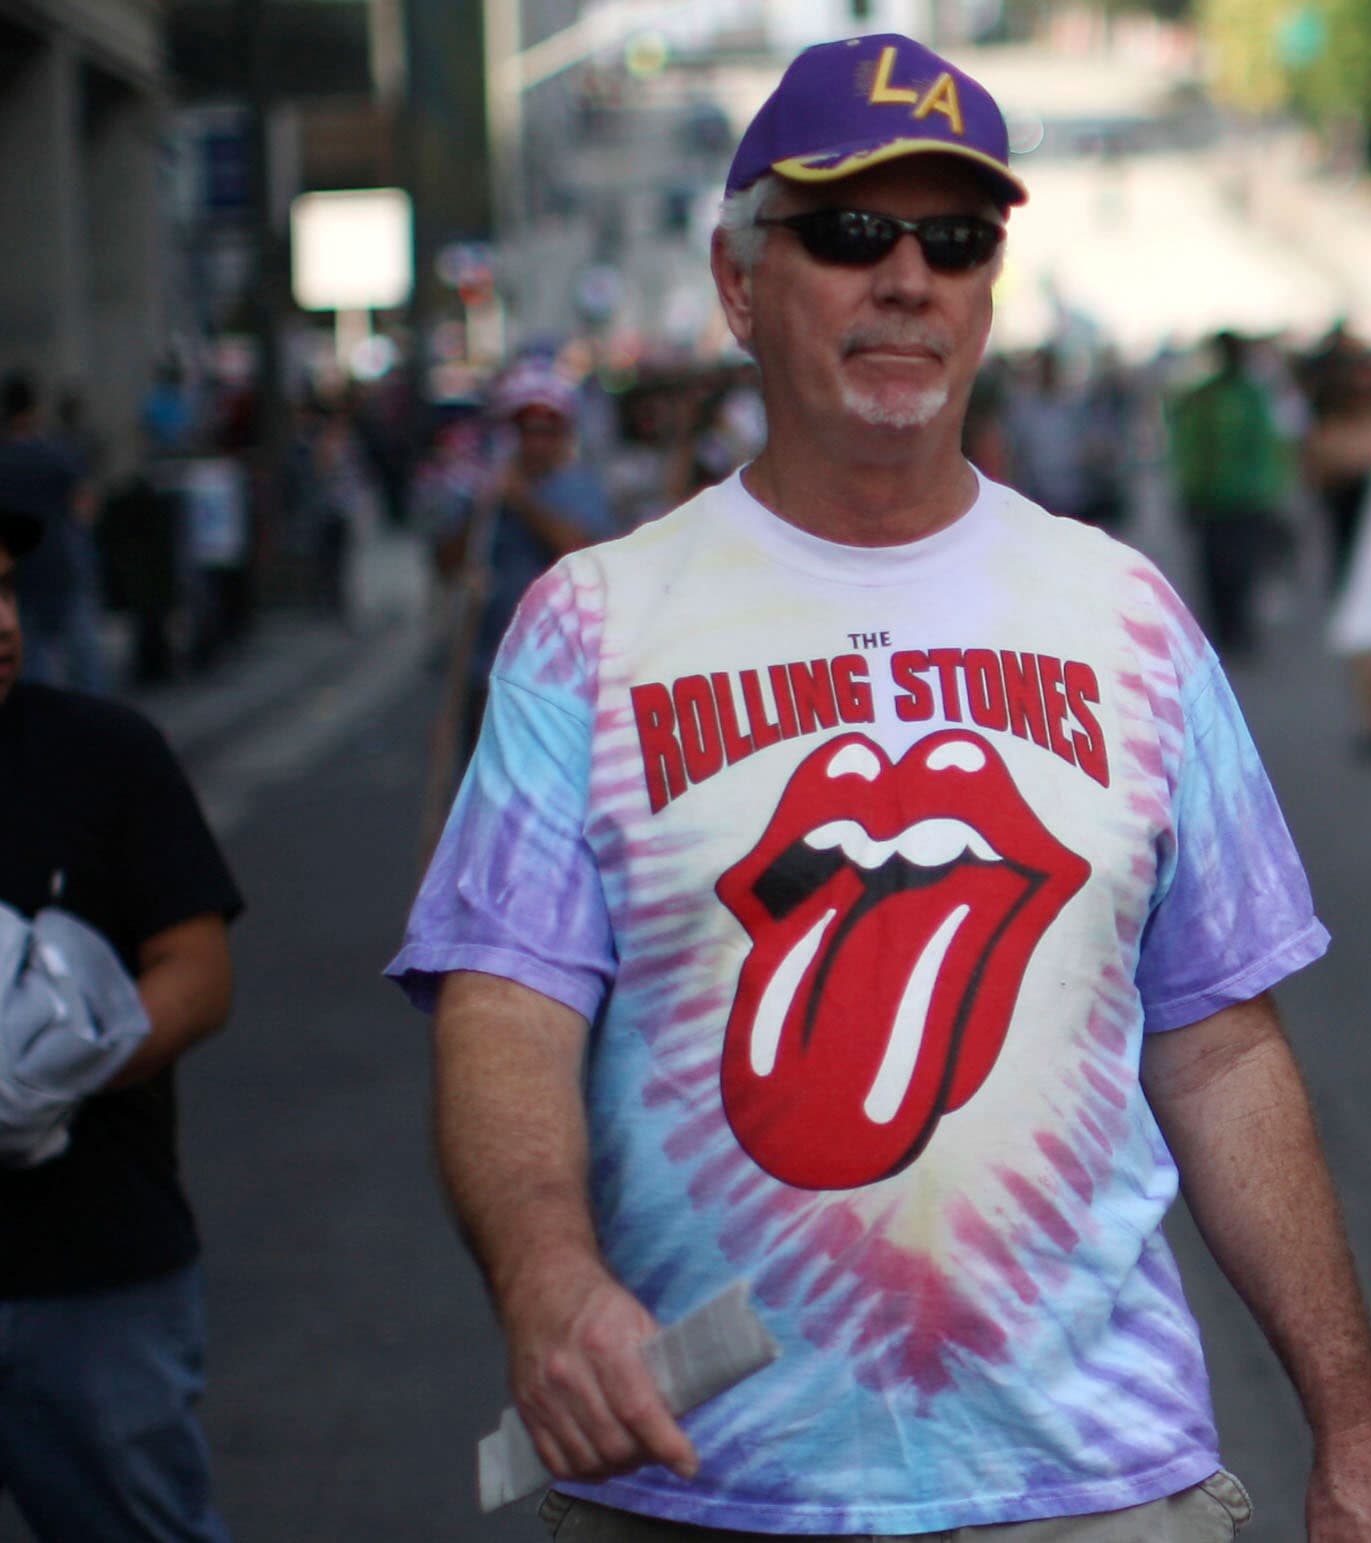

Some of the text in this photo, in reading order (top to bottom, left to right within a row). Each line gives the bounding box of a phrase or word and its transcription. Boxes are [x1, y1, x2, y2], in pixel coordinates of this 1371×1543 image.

[869, 46, 964, 136] LA
[847, 630, 892, 649] THE
[630, 648, 1110, 815] ROLLING STONES
